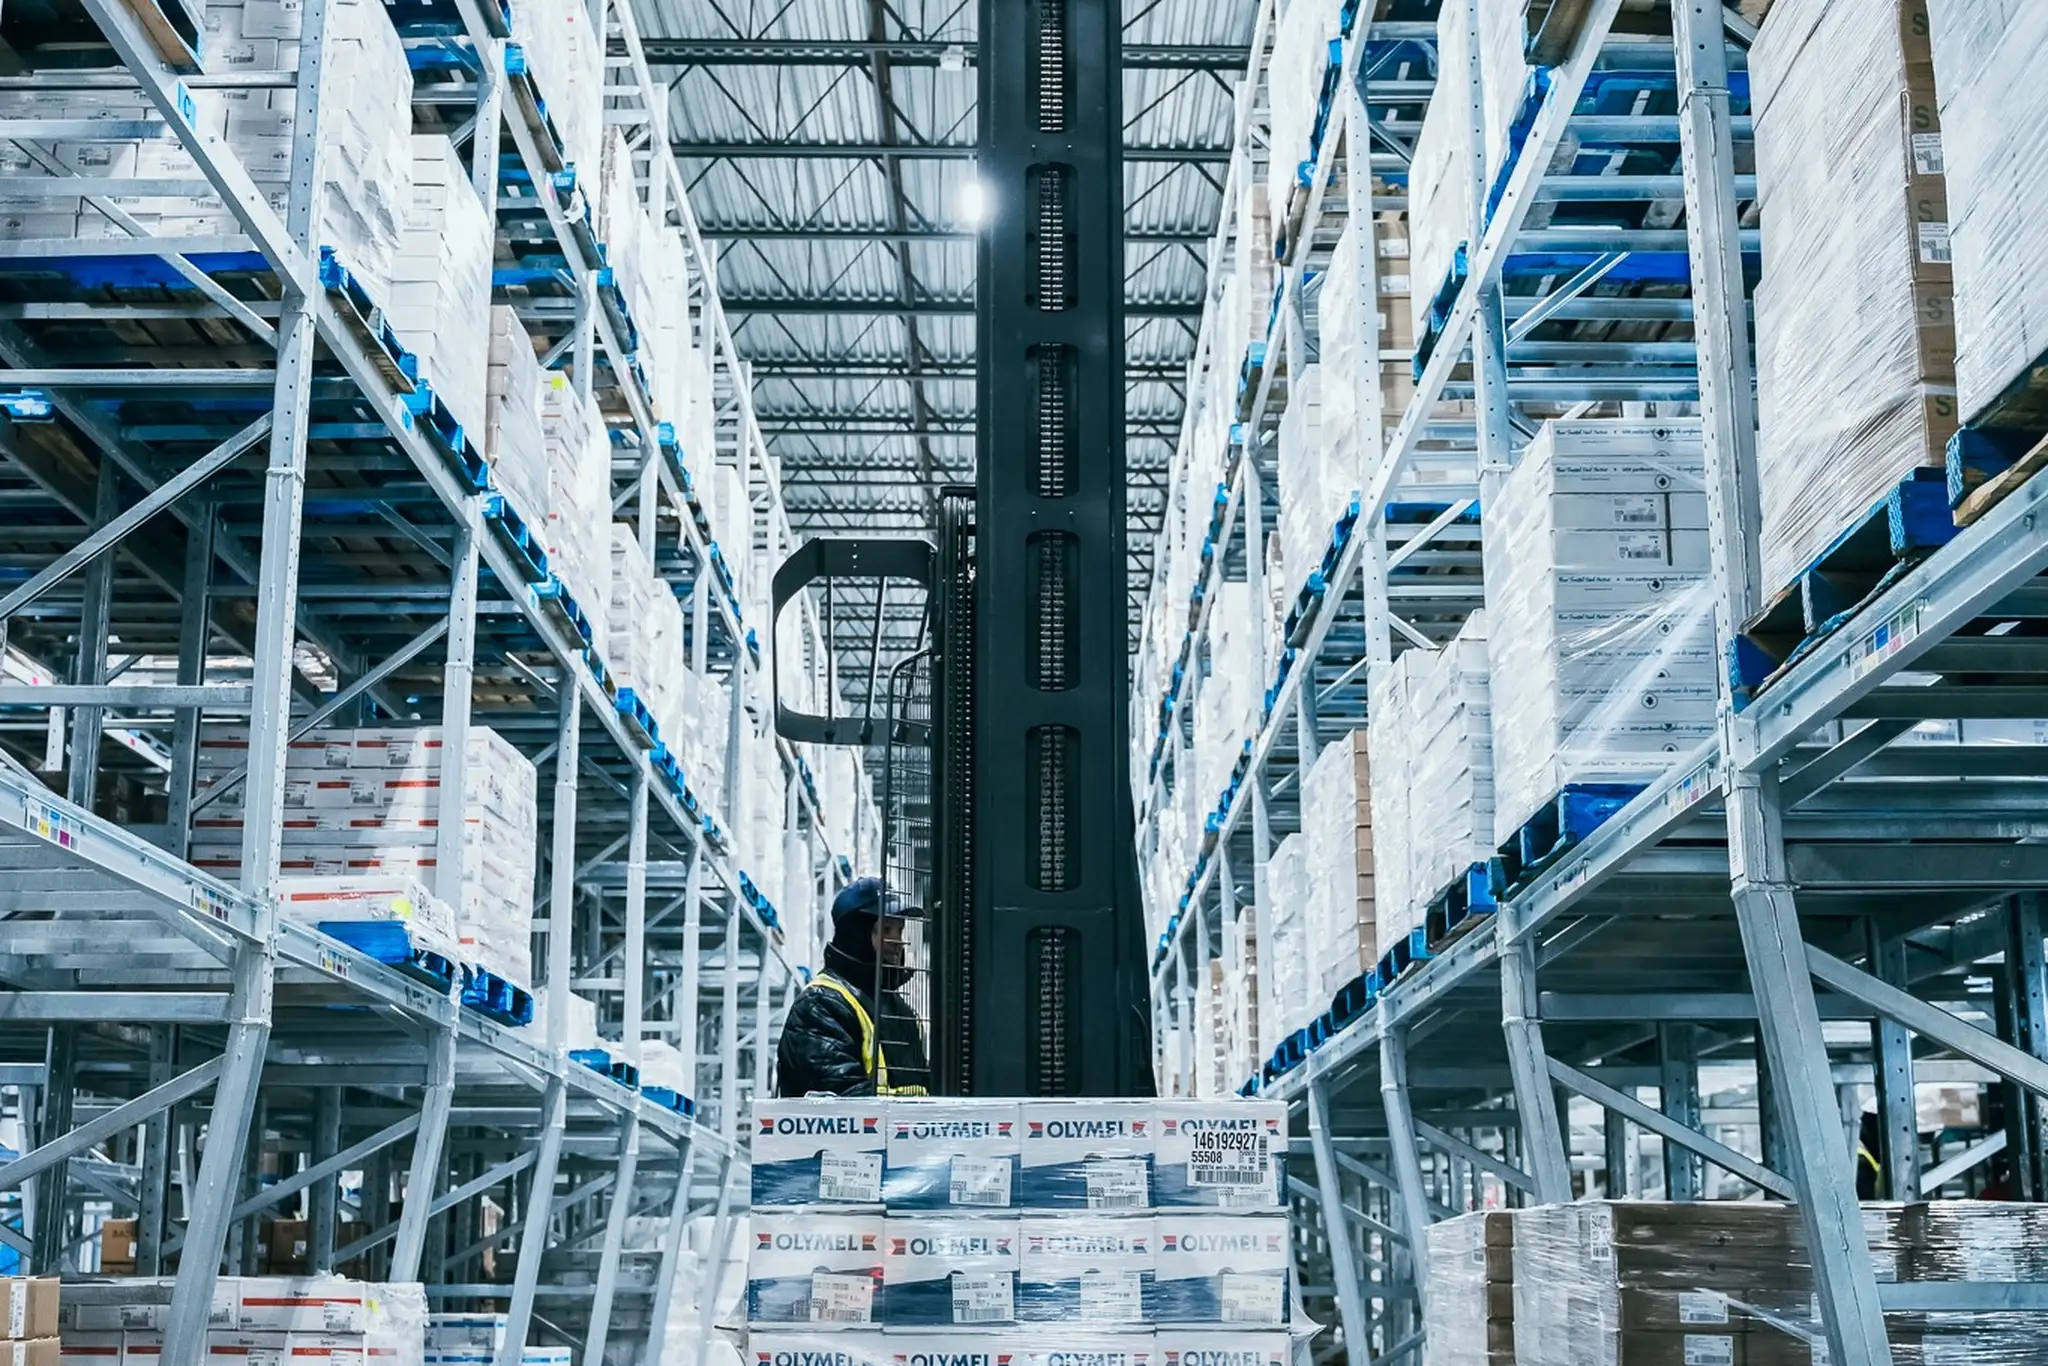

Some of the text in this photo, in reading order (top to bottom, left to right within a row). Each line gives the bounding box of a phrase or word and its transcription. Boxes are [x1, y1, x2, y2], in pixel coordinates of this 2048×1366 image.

[778, 1117, 860, 1135] OLYMEL
[912, 1121, 993, 1140] OLYMEL
[1047, 1120, 1128, 1139] OLYMEL
[1192, 1131, 1257, 1151] 146192927
[1191, 1150, 1223, 1164] 55508
[775, 1233, 858, 1251] OLYMEL
[1181, 1234, 1261, 1252] OLYMEL
